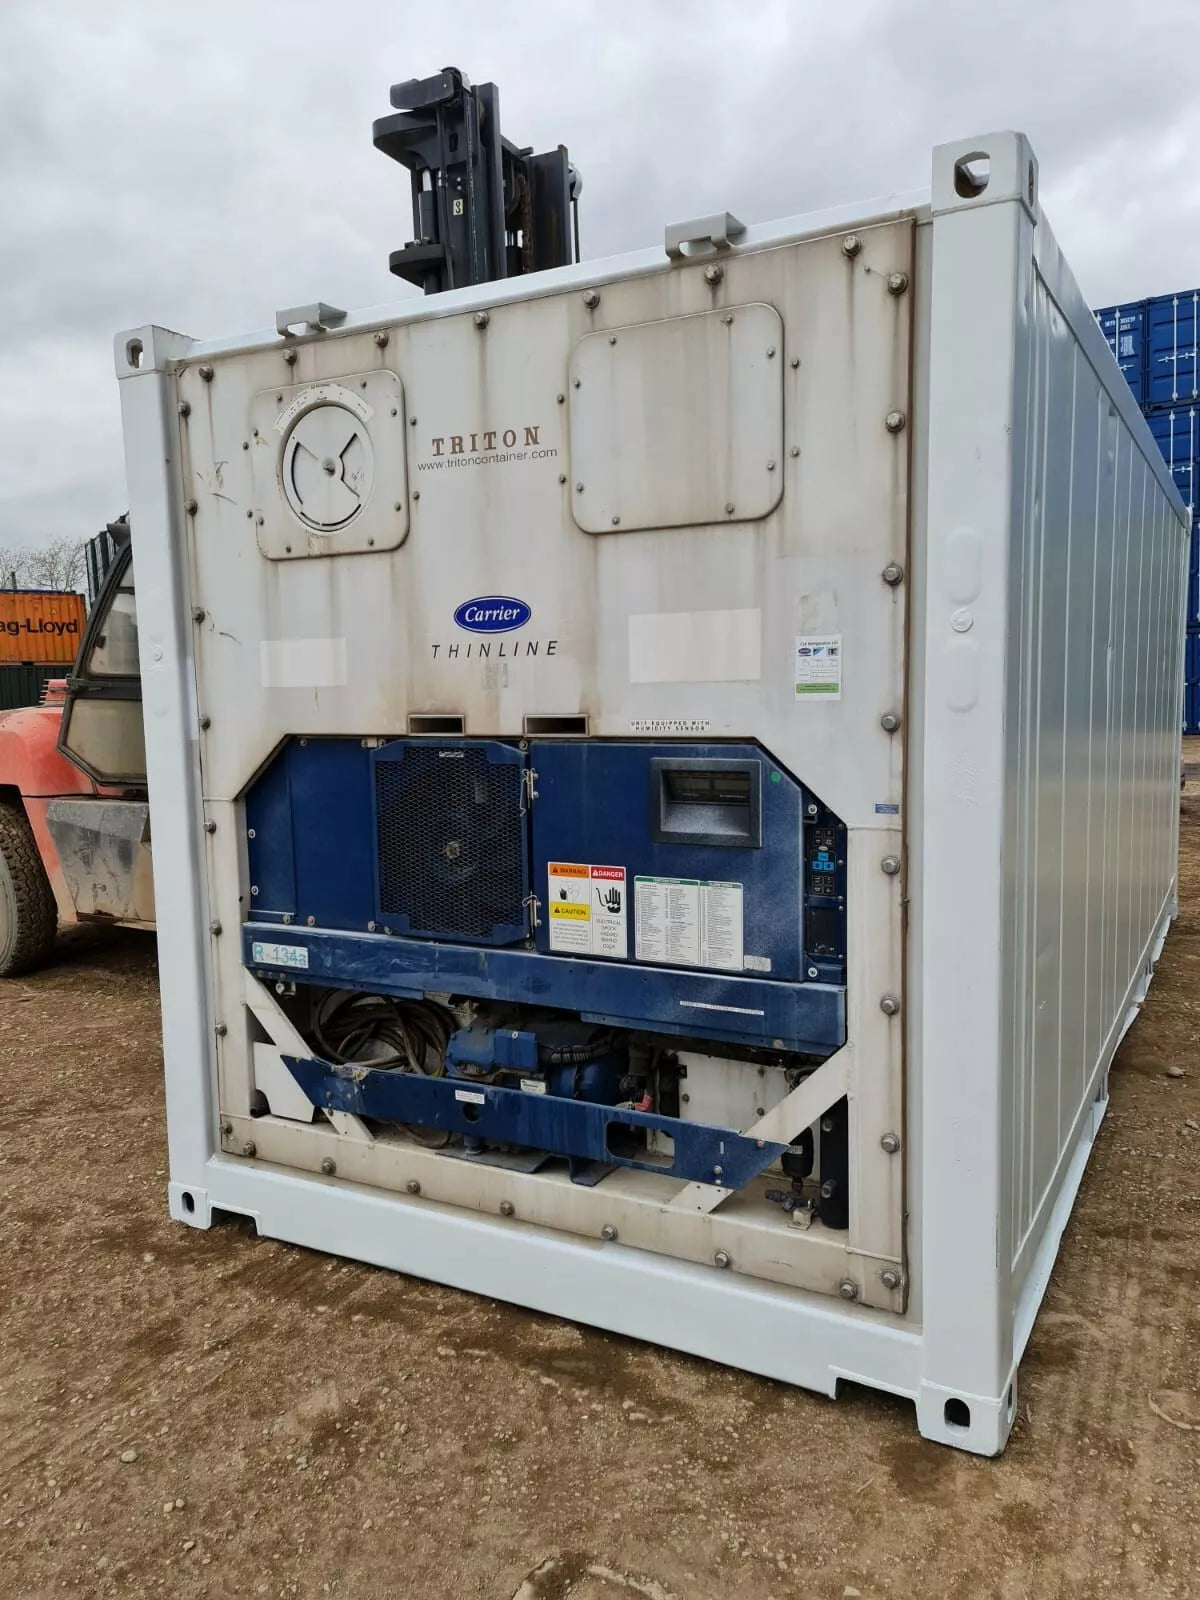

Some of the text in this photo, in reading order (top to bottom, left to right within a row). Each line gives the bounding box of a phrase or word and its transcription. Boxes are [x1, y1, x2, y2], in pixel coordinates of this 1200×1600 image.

[432, 426, 540, 457] TRITON
[417, 448, 558, 472] www.tritoncontainer.com
[465, 605, 520, 623] Carrier
[431, 640, 558, 659] THINLINE
[599, 870, 624, 878] DANGER
[561, 908, 586, 916] CAUTION
